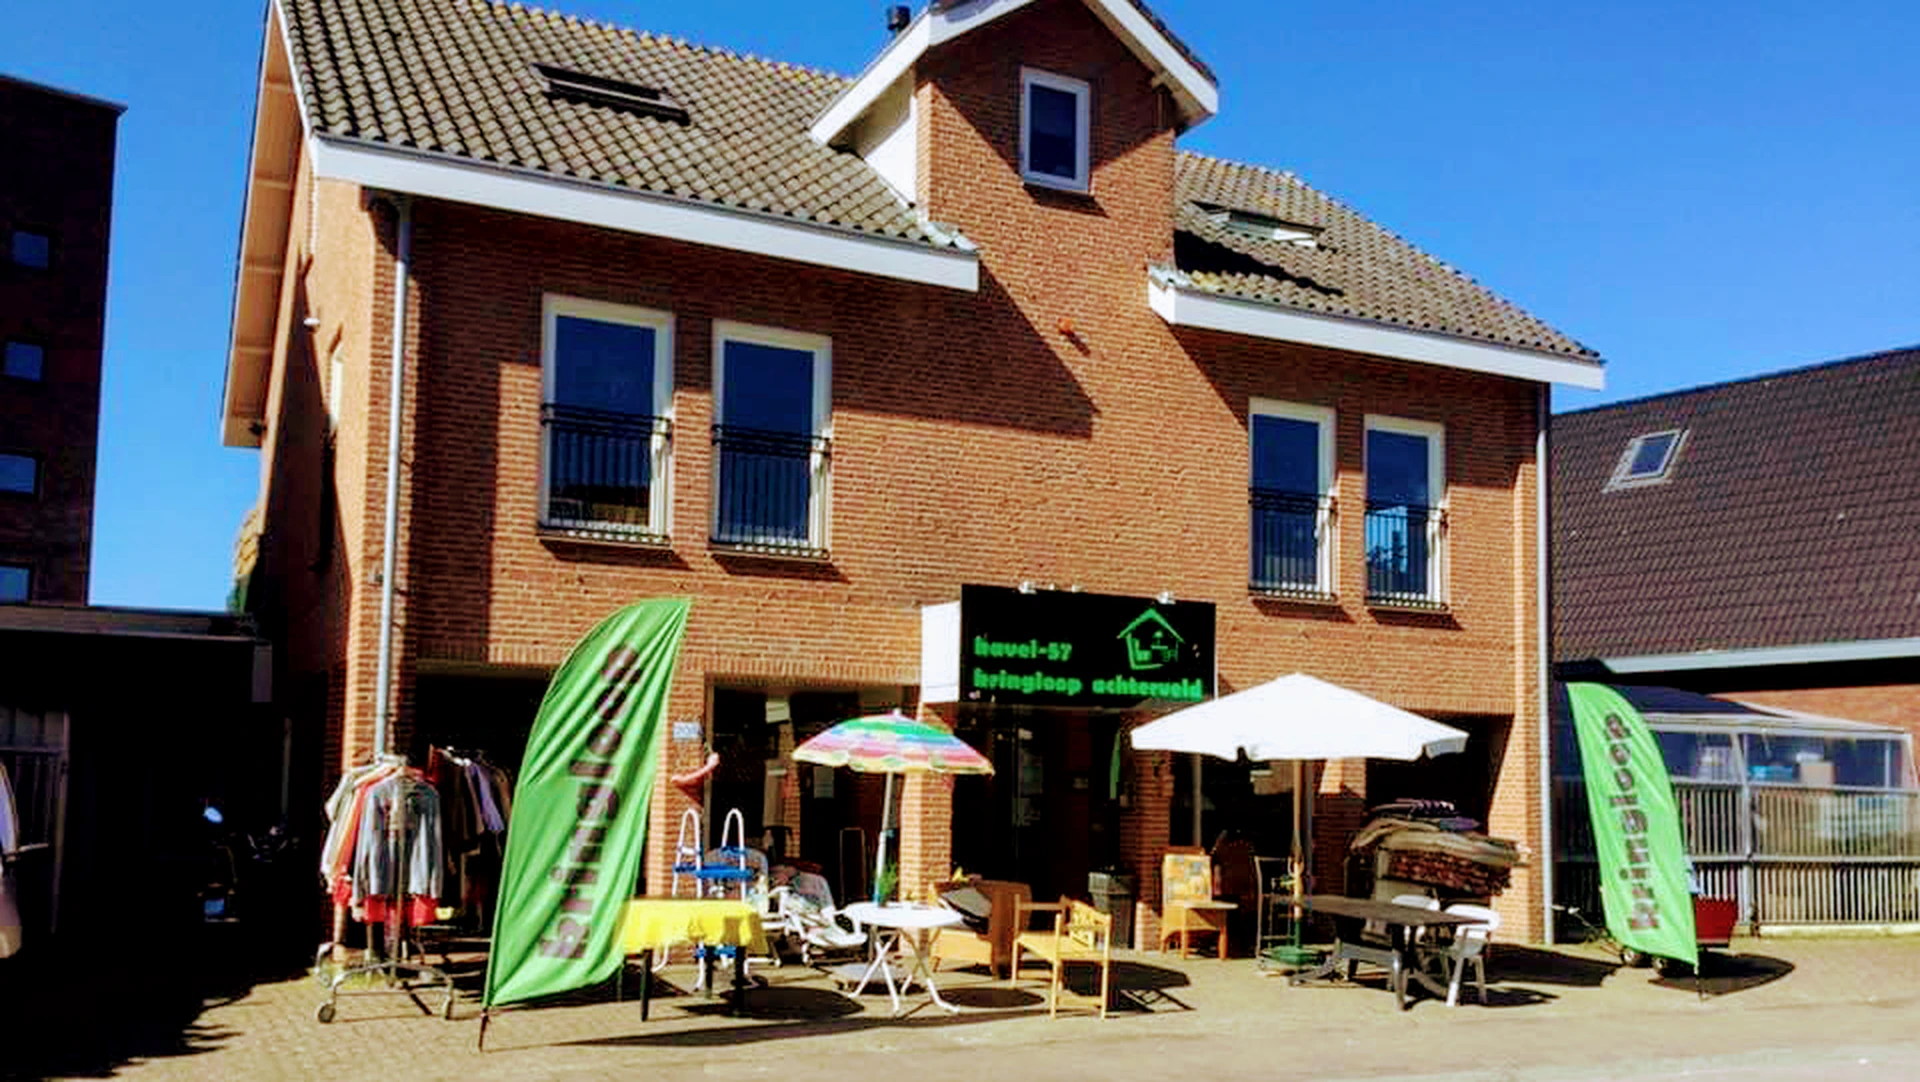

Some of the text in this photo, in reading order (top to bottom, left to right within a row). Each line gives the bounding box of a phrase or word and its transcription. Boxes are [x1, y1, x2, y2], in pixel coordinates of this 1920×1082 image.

[974, 668, 1203, 701] kringloop achterveld
[1603, 711, 1661, 931] kringloop
